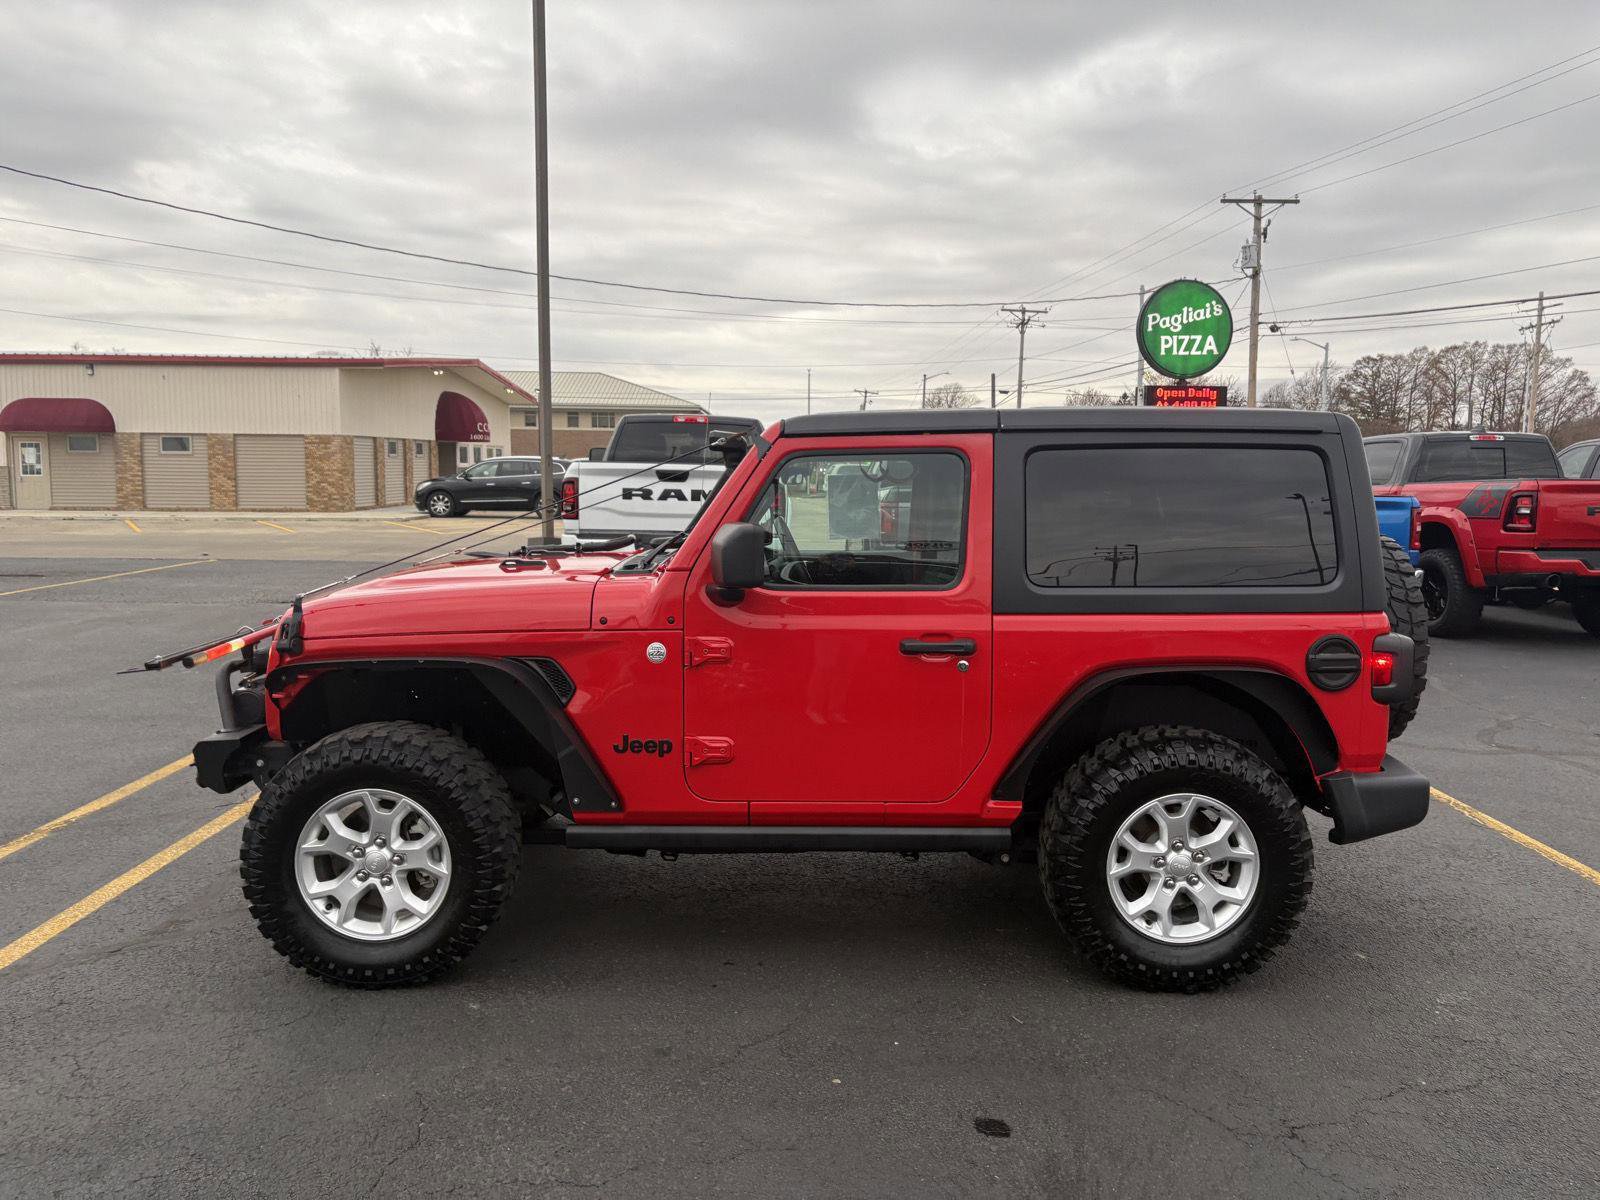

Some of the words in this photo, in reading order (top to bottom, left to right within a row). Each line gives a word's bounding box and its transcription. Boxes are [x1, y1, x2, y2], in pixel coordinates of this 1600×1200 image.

[1147, 300, 1223, 333] Pagliai's
[1160, 335, 1219, 356] PIZZA
[1156, 387, 1185, 400] Open
[1188, 387, 1217, 400] Daily
[613, 734, 673, 758] Jeep
